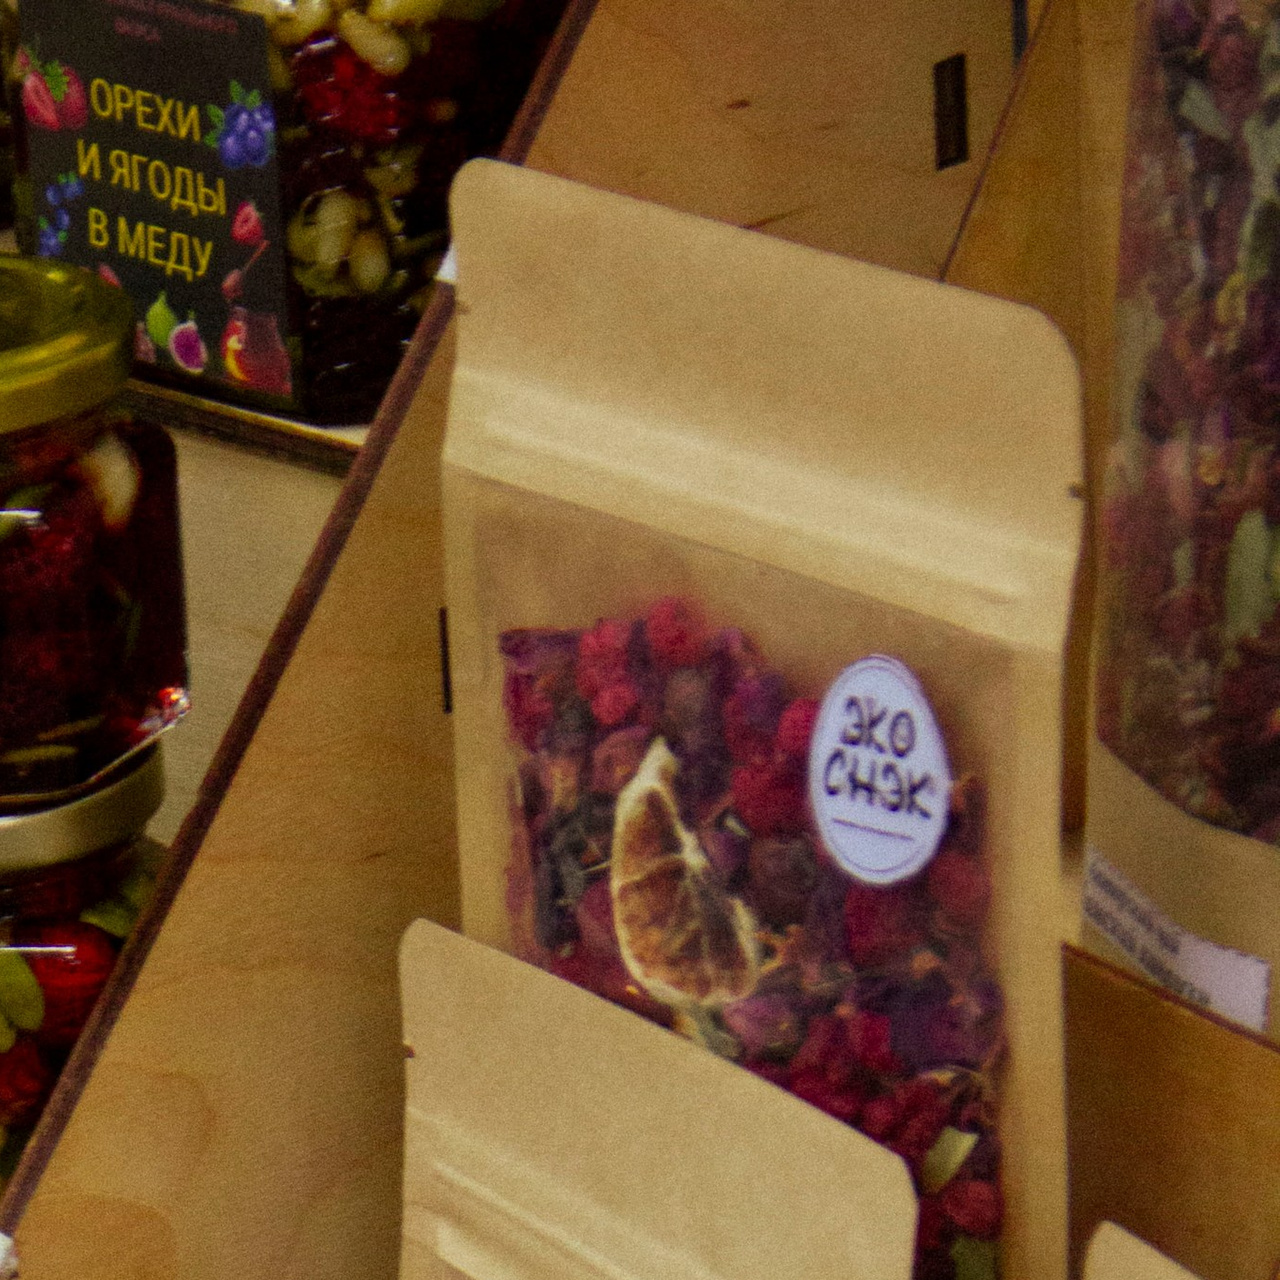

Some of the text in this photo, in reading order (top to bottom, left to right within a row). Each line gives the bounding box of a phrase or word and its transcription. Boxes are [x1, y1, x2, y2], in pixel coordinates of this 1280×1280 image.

[90, 77, 201, 143] ОРЕХИ
[76, 138, 227, 217] И ЯГОДЫ
[87, 206, 213, 282] В МЕДУ
[839, 695, 917, 760] ЭКО
[823, 748, 936, 821] СНЭК
